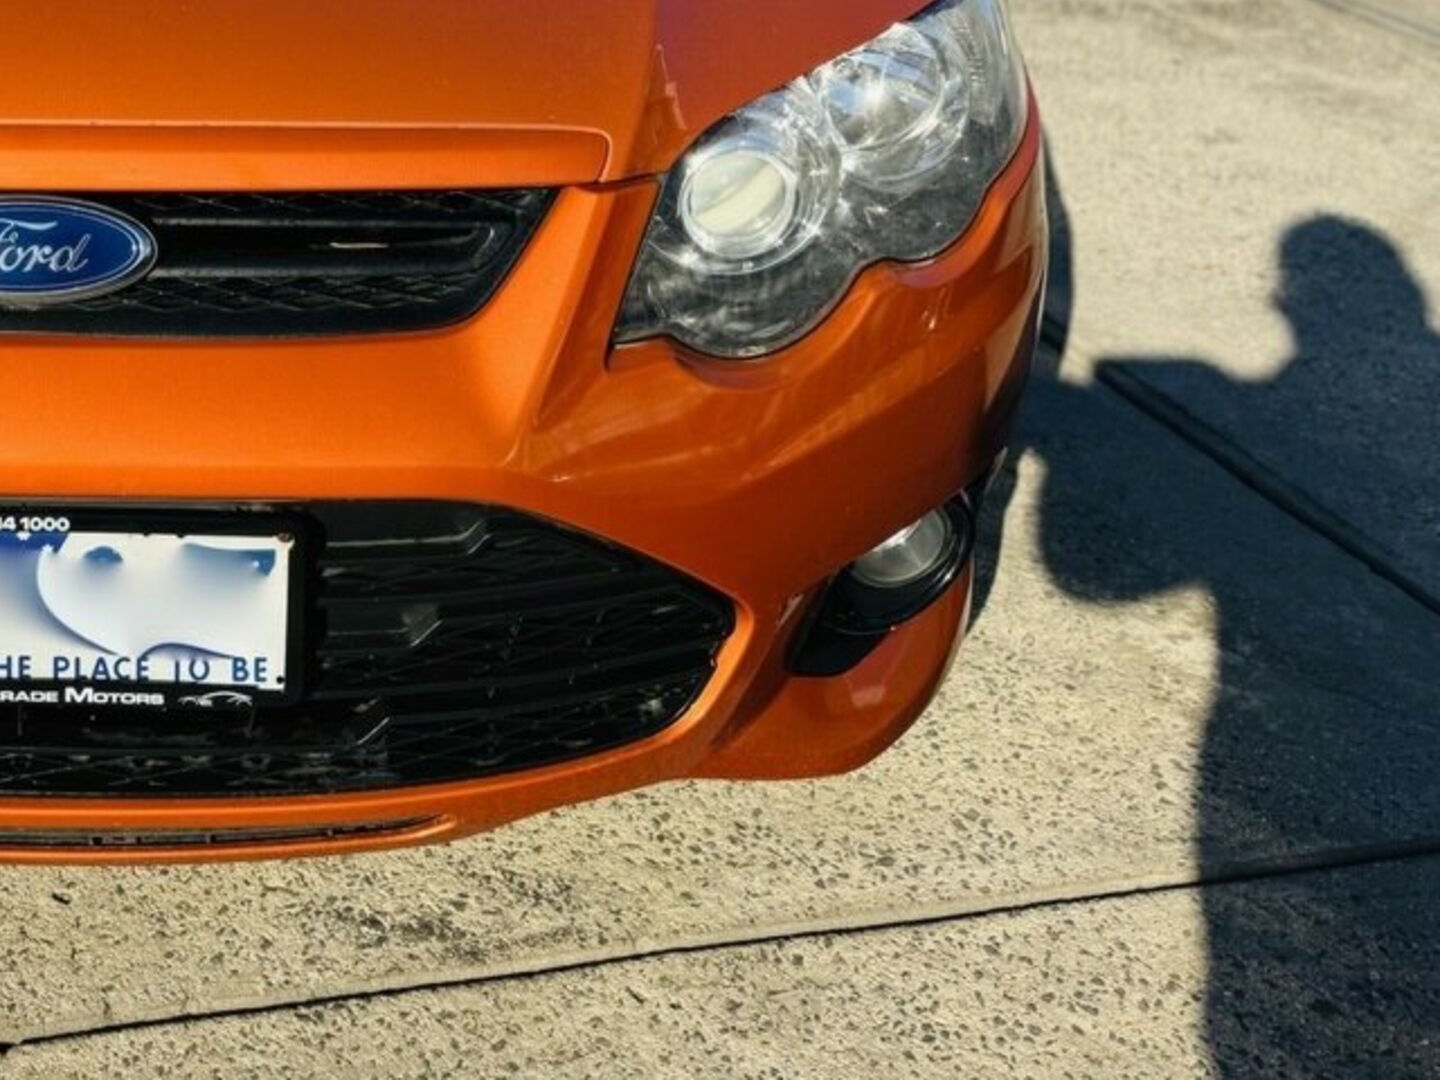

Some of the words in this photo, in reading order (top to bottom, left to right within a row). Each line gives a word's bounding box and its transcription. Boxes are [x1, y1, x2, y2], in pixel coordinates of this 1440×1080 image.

[19, 516, 71, 532] 1000
[53, 655, 150, 683] PLACE
[231, 656, 268, 683] BE
[64, 686, 166, 706] MOTORS
